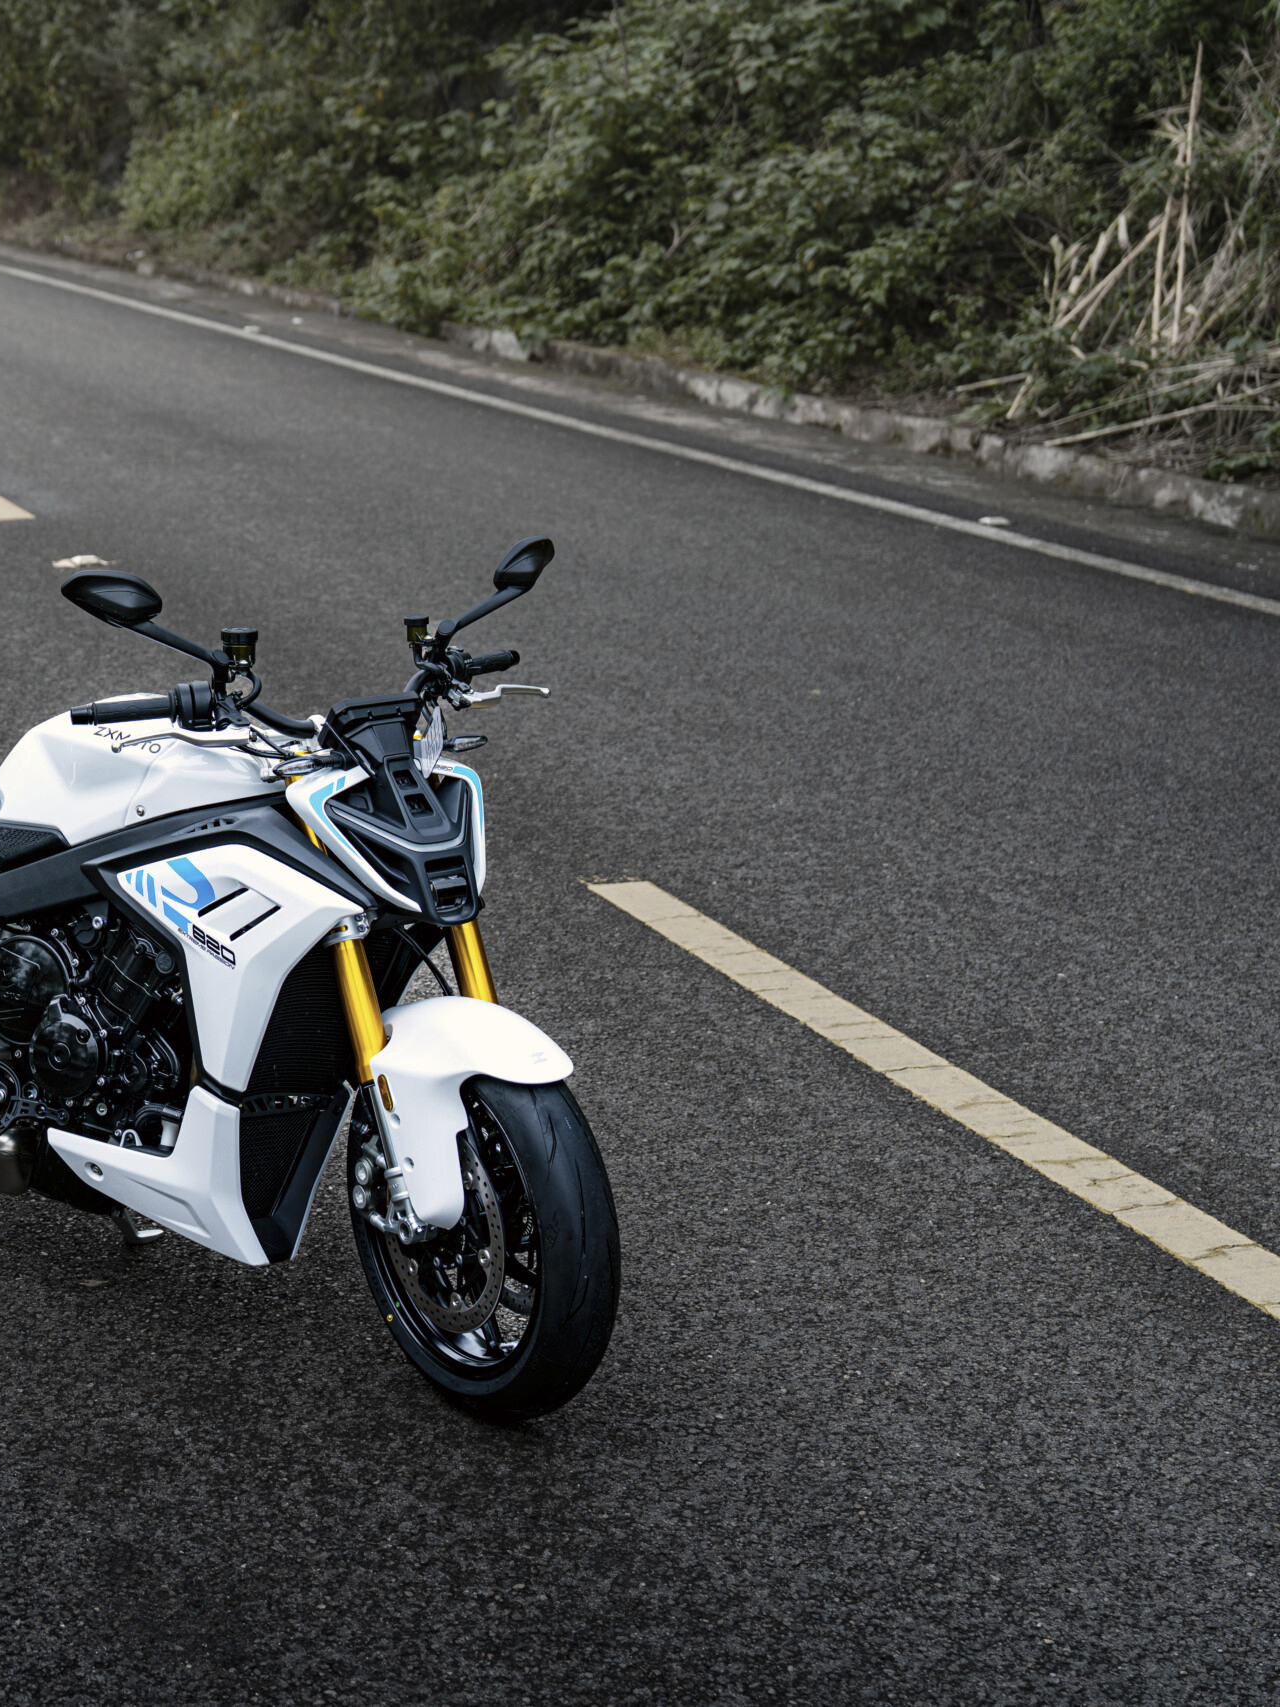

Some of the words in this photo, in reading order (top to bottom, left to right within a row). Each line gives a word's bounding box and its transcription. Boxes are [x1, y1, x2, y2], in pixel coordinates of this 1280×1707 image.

[93, 726, 162, 754] ZXMTO
[177, 927, 207, 952] EXTREME
[206, 949, 235, 970] PASSION
[192, 923, 236, 966] 820
